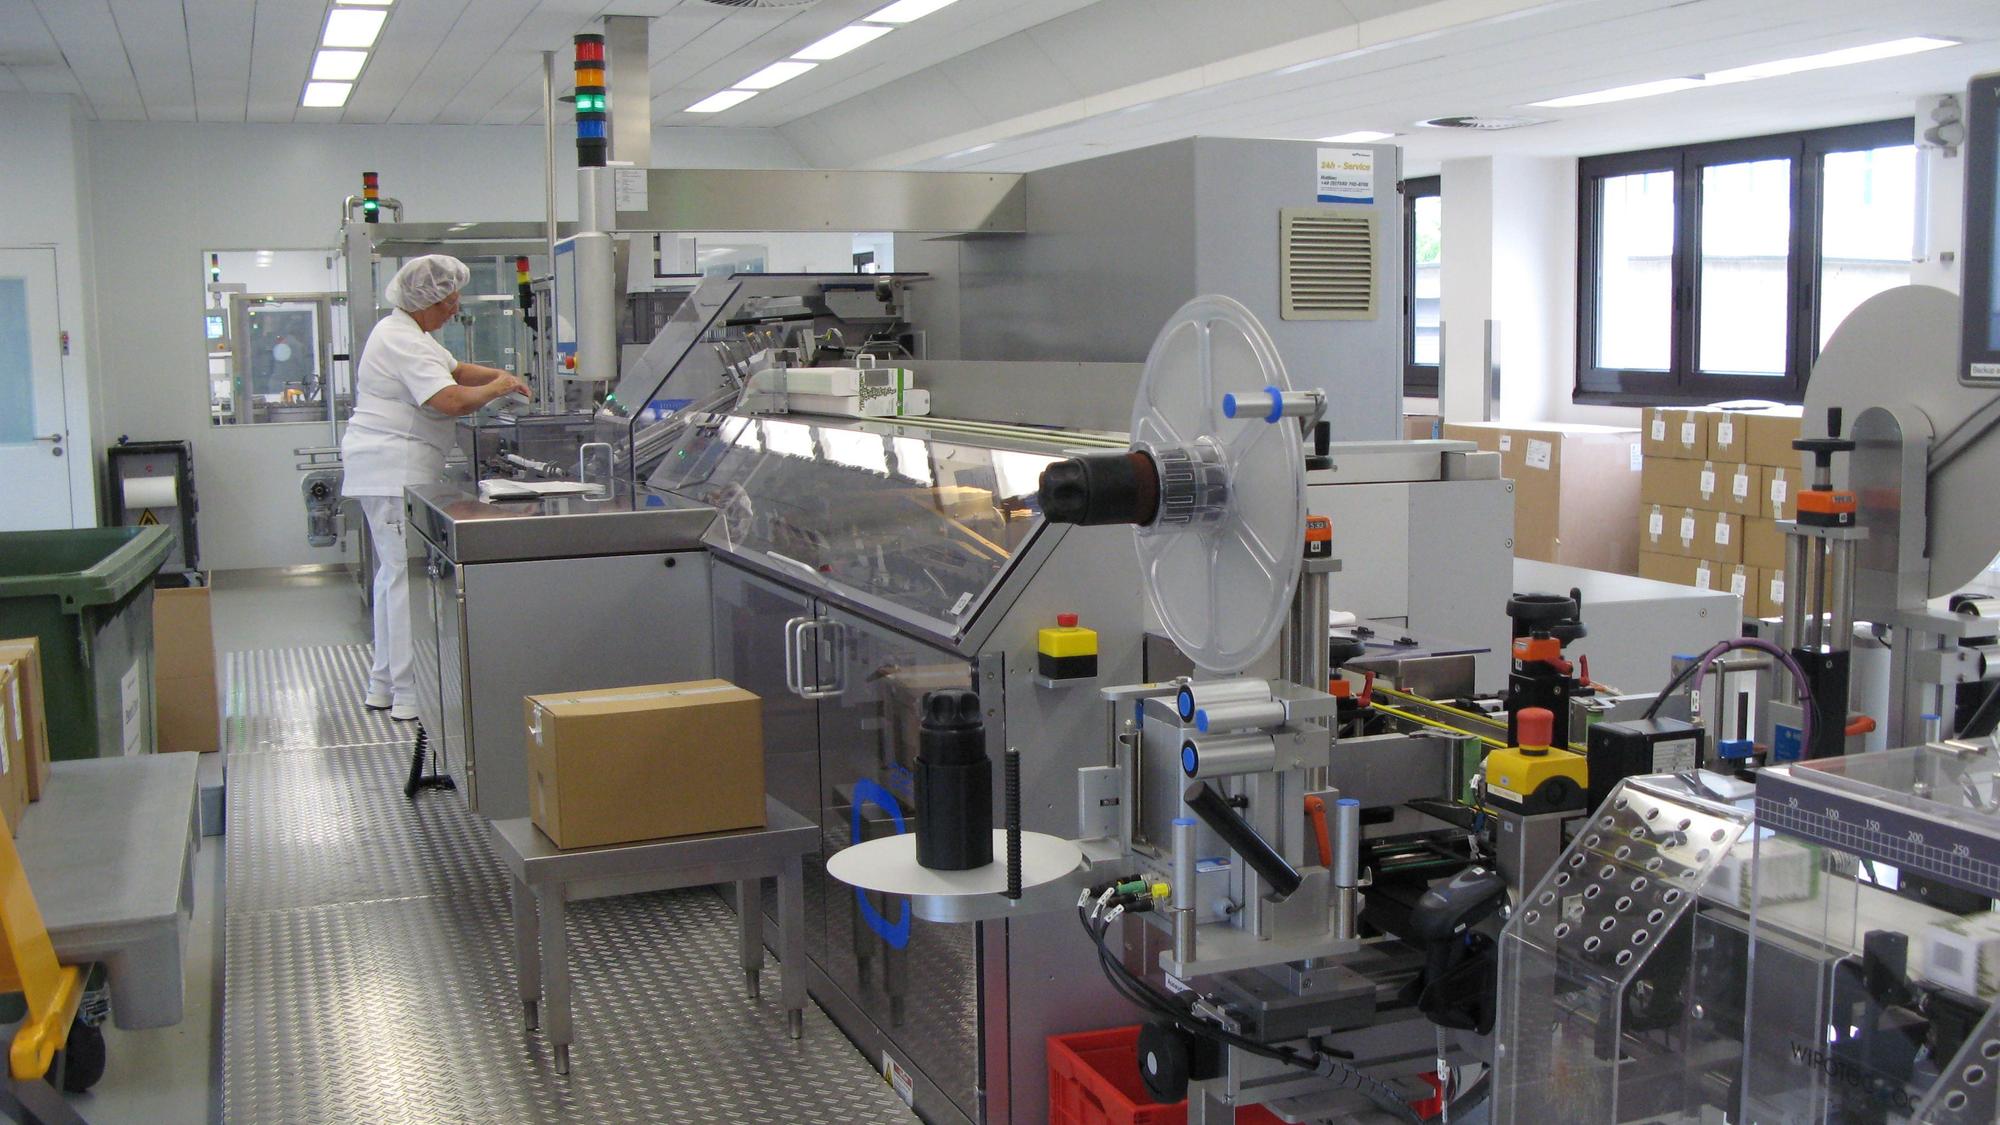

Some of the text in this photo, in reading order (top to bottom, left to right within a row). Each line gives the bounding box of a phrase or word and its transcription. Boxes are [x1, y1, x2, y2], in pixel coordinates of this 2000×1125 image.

[1321, 161, 1335, 169] 24h
[1343, 162, 1370, 171] Service
[1788, 797, 1970, 857] 50 100 150 200 250
